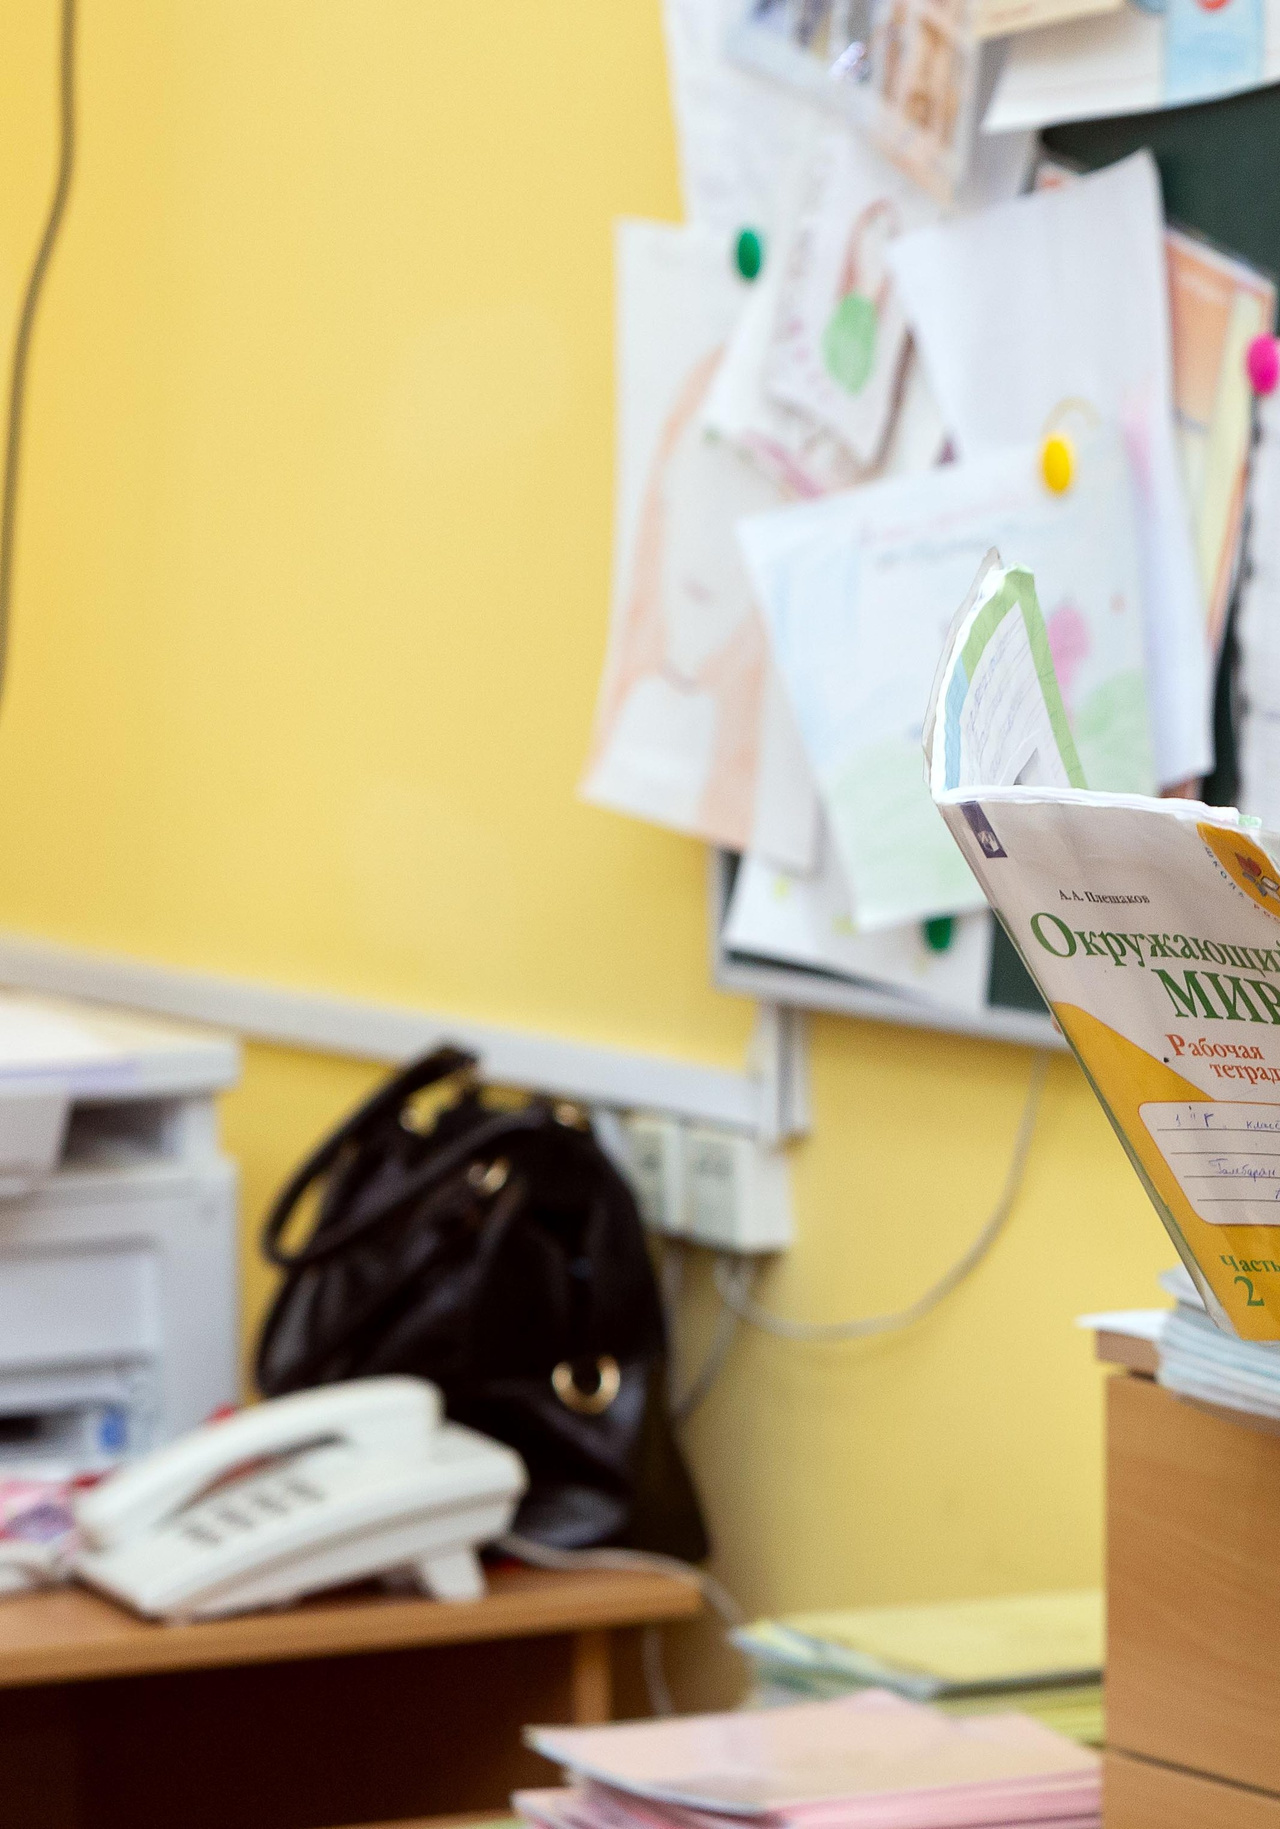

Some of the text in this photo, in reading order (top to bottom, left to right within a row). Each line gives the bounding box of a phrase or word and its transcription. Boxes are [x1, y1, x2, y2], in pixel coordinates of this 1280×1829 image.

[1084, 891, 1150, 903] Плешаков
[1164, 1034, 1265, 1060] Рабочая
[1233, 1275, 1265, 1307] 2
